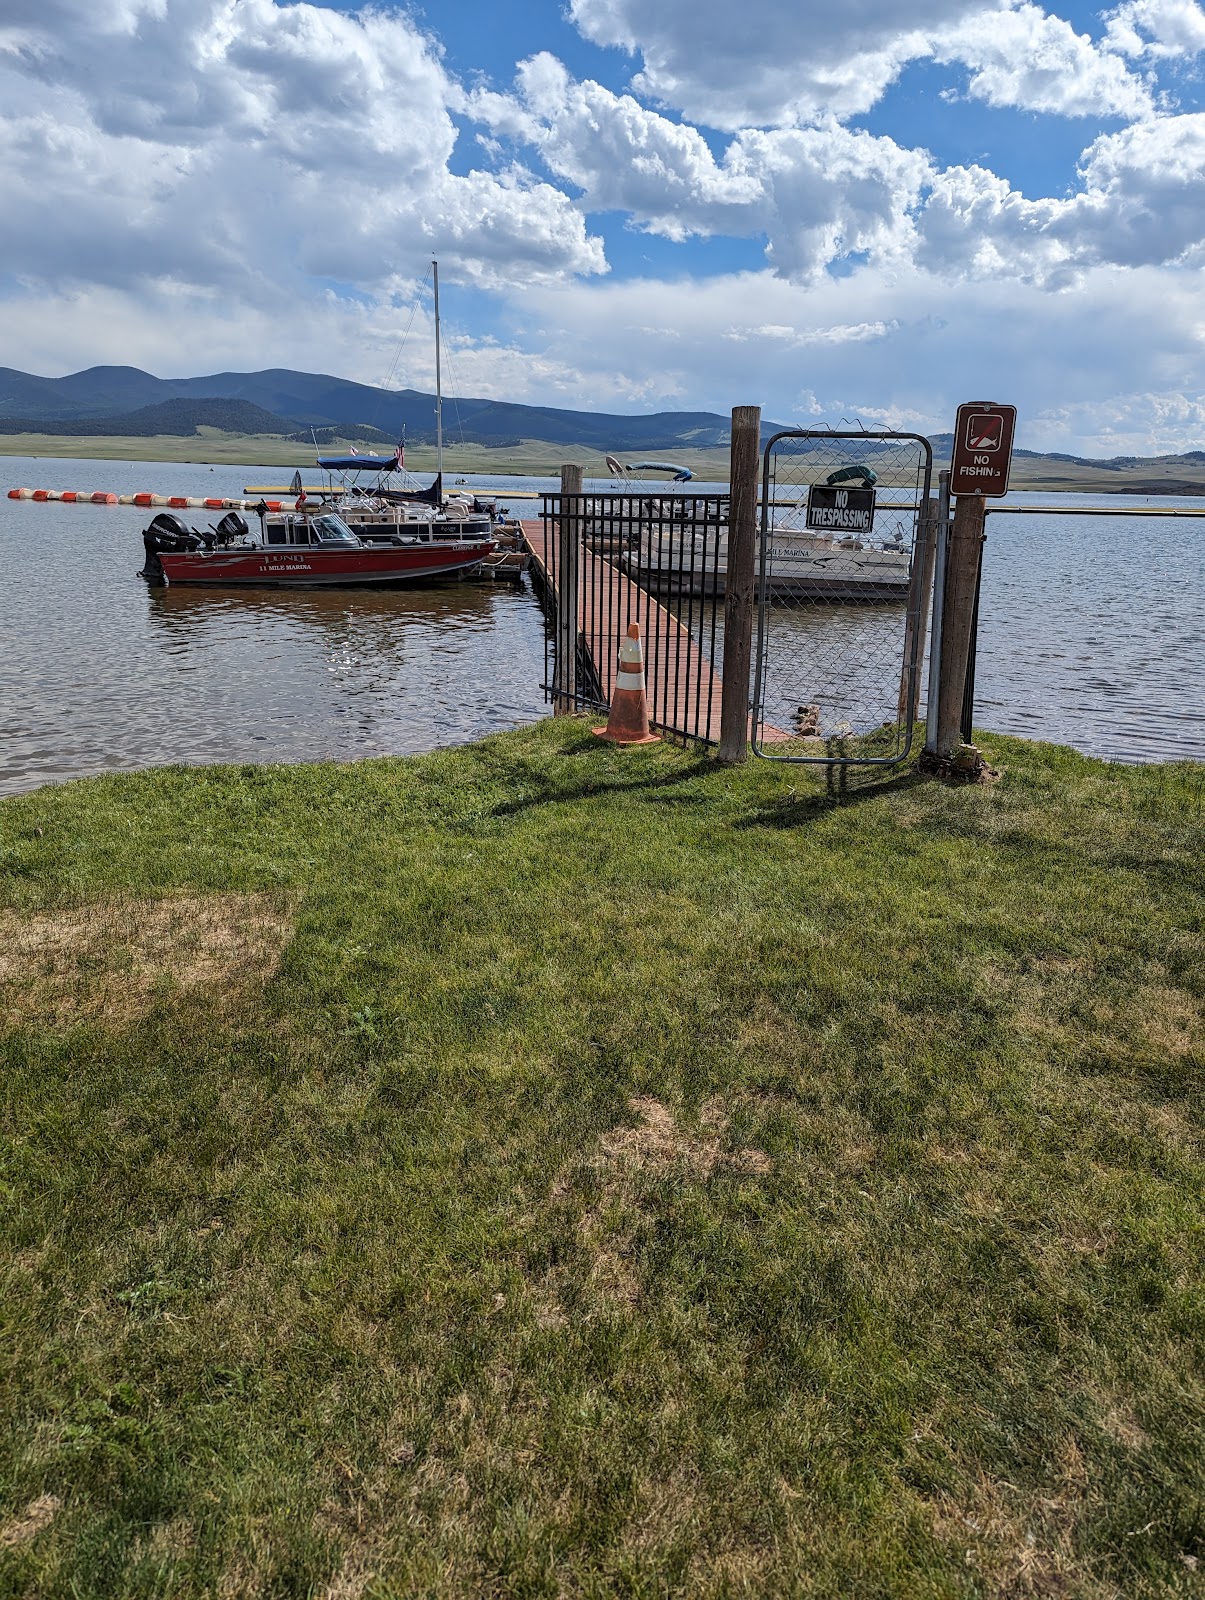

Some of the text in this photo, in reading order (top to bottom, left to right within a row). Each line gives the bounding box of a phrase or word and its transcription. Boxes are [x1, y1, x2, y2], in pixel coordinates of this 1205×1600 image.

[973, 455, 990, 465] NO
[834, 490, 849, 508] NO
[811, 507, 870, 528] TRESPASSING
[783, 549, 810, 557] MARINA
[263, 554, 305, 564] LUND
